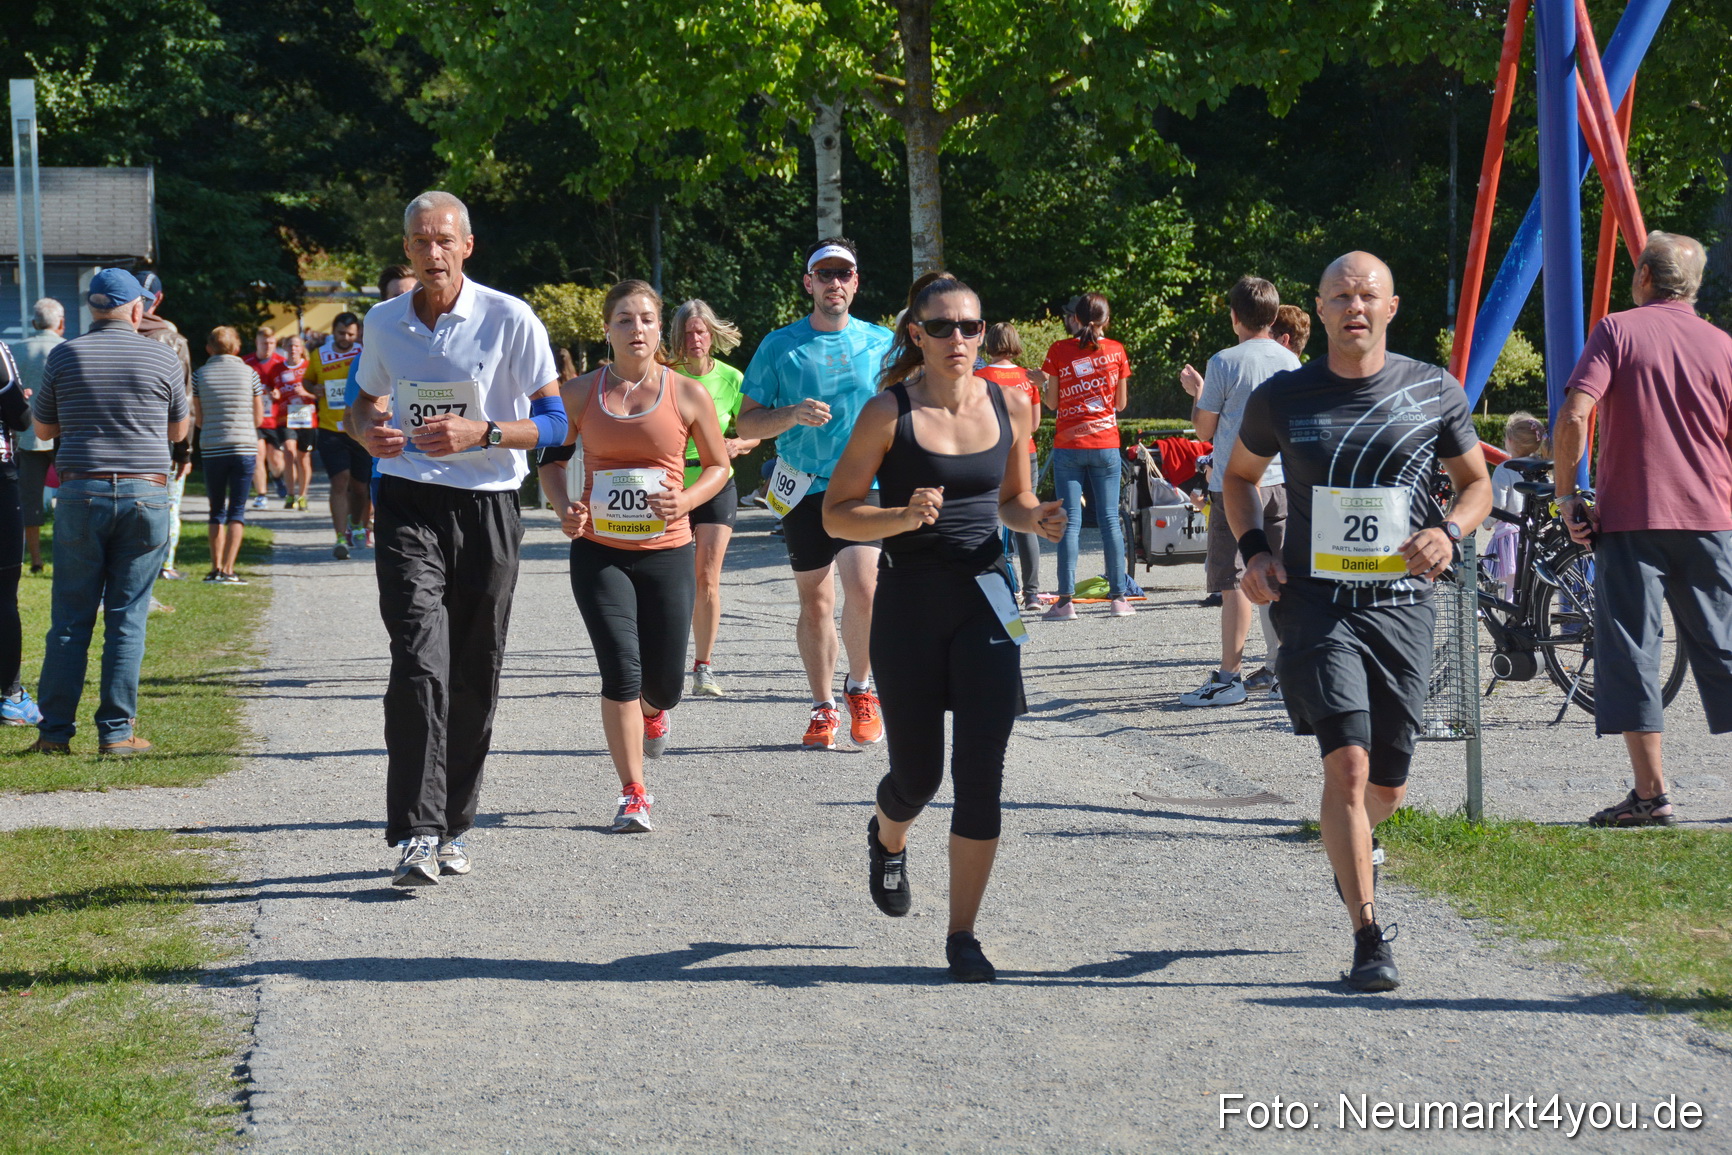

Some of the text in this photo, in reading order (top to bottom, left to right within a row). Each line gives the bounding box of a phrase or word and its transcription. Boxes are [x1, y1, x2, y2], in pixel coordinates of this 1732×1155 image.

[994, 370, 1020, 380] Team
[418, 388, 454, 398] BOCK
[409, 402, 467, 427] 3077
[612, 475, 644, 484] BOCK
[776, 471, 797, 496] 199
[608, 489, 648, 511] 203
[1340, 496, 1383, 508] BOCK
[608, 522, 651, 533] Franziska
[1343, 514, 1379, 542] 26
[1342, 558, 1379, 571] Daniel
